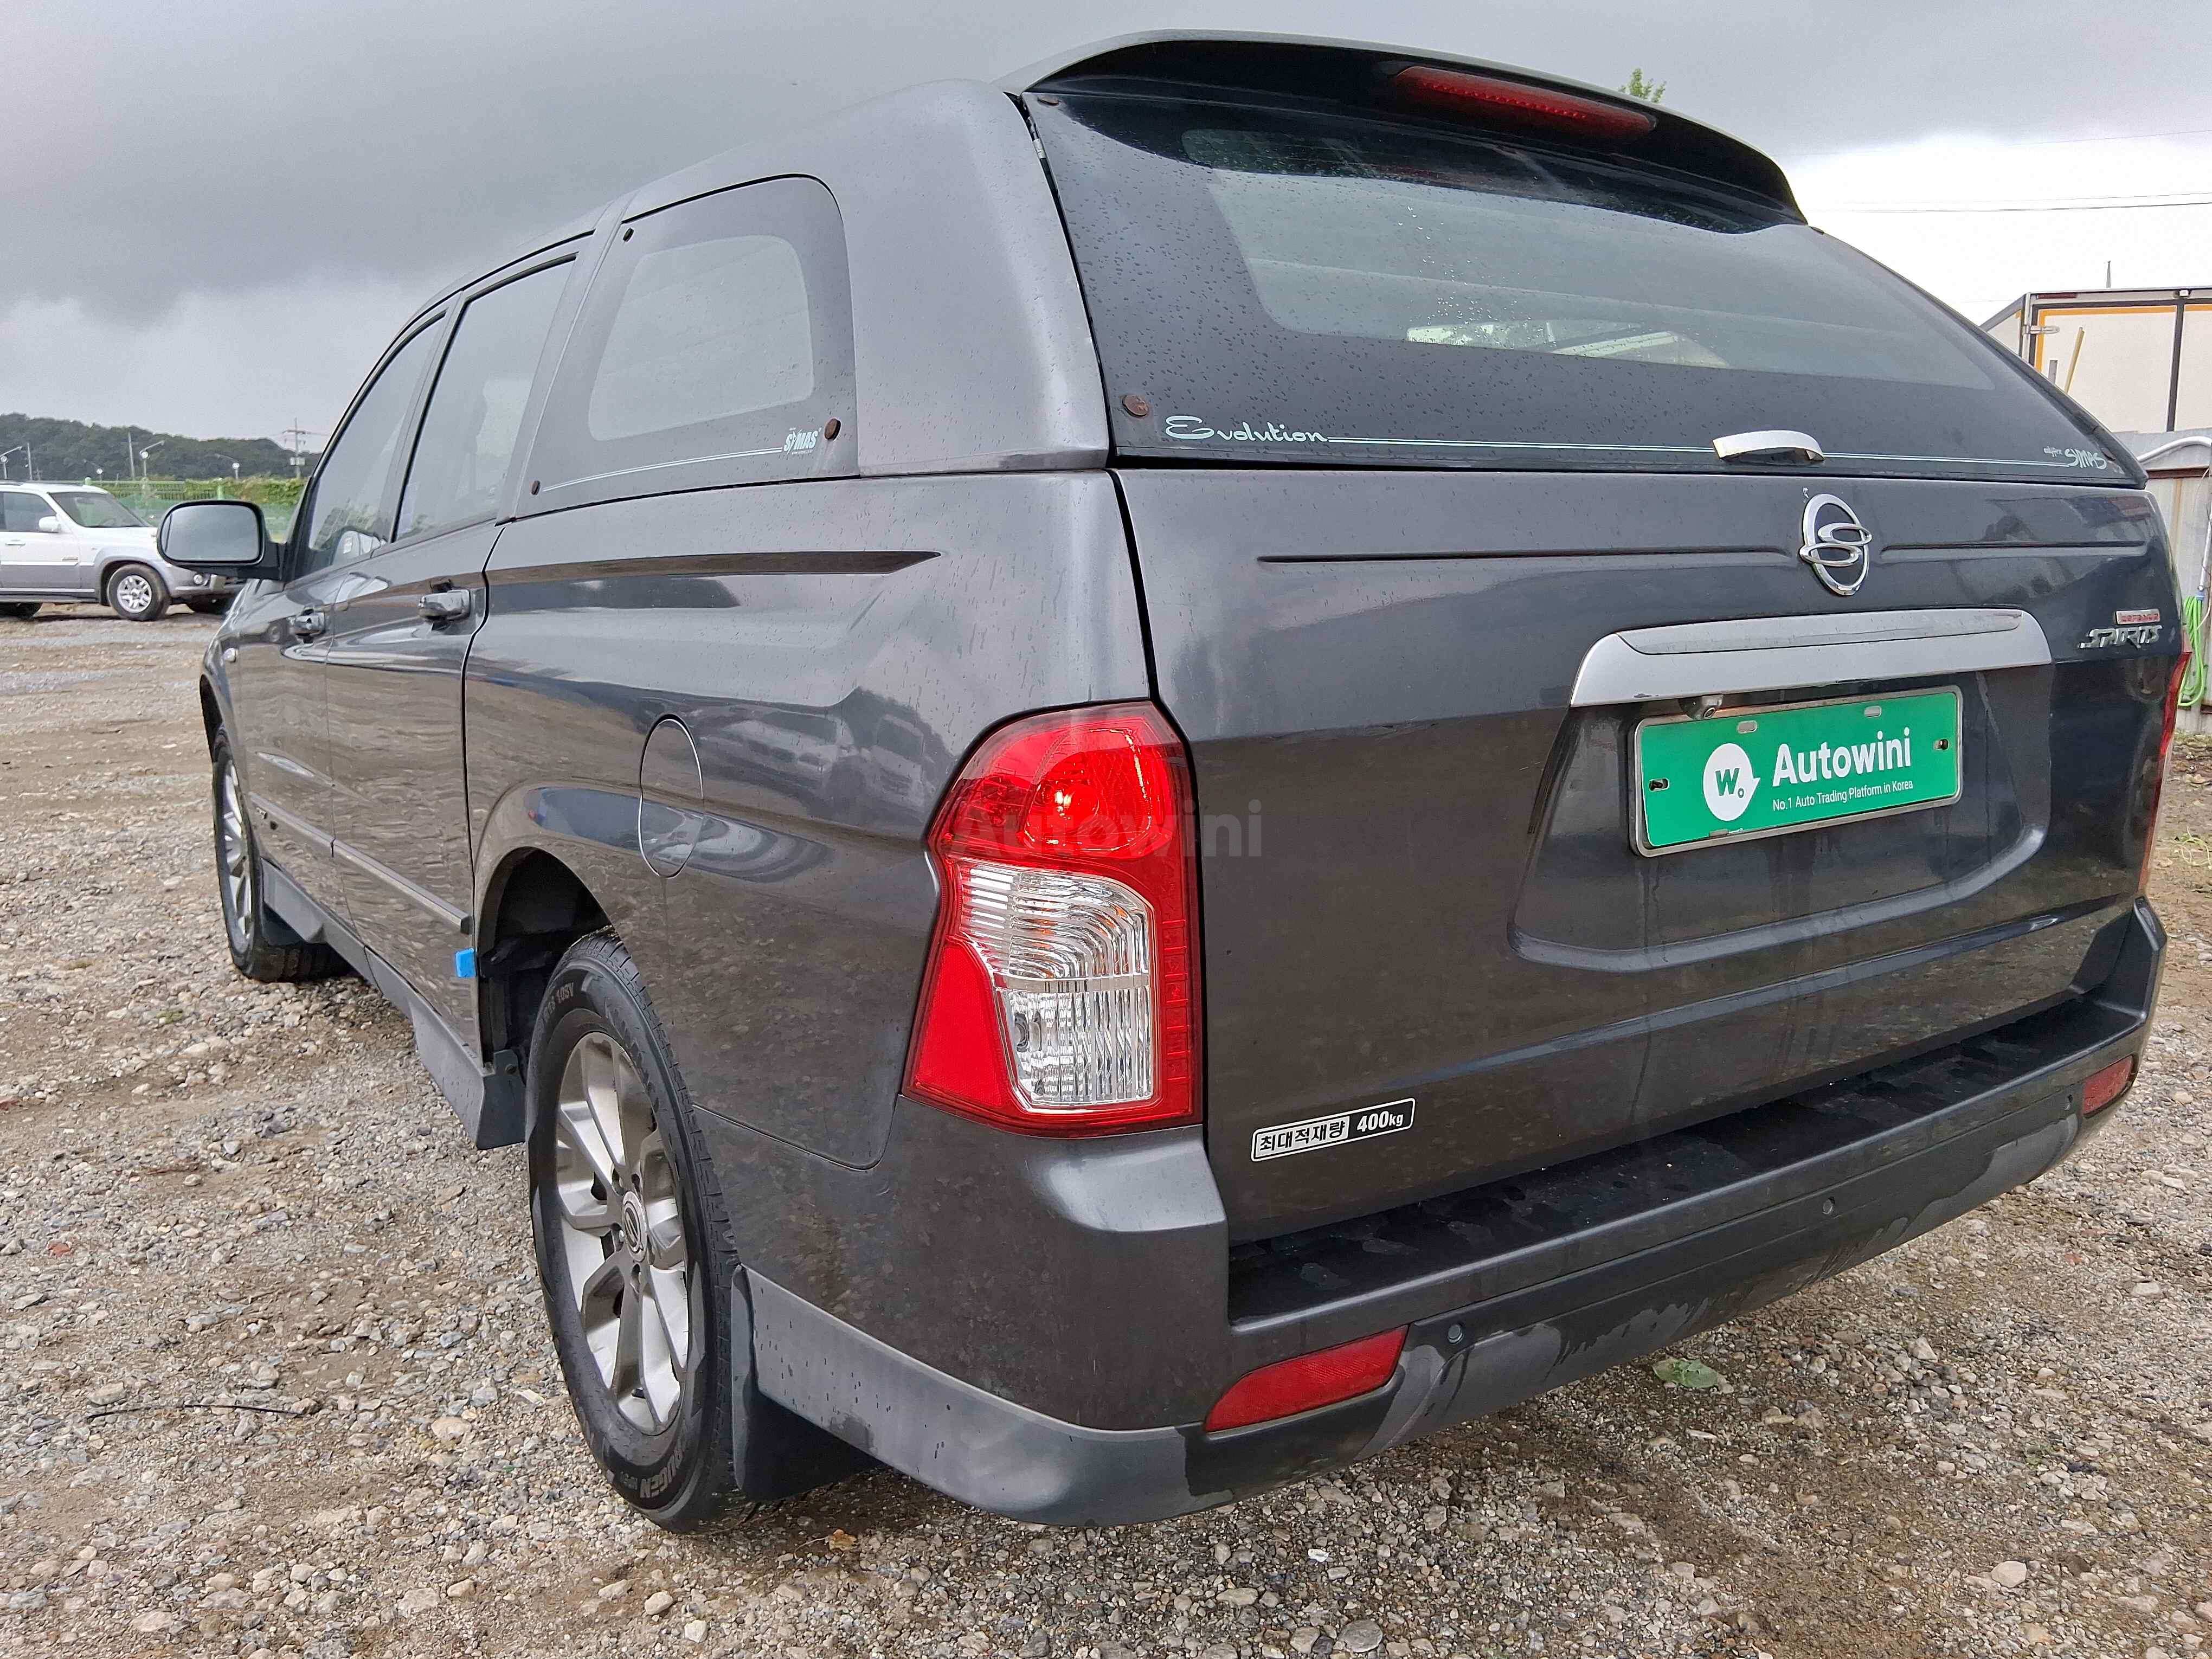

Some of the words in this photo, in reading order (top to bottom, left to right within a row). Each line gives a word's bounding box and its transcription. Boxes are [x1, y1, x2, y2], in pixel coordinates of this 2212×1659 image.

[1165, 415, 1328, 442] Evolution
[1772, 726, 1911, 787] Autowini
[1773, 799, 1792, 811] No.1
[1796, 795, 1815, 807] Auto
[1816, 790, 1847, 803] Trading
[1849, 785, 1882, 799] Platform
[1883, 782, 1891, 793] in
[1892, 780, 1913, 792] Korea
[1259, 1120, 1346, 1151] 최대적재량
[1357, 1110, 1404, 1132] 400kg
